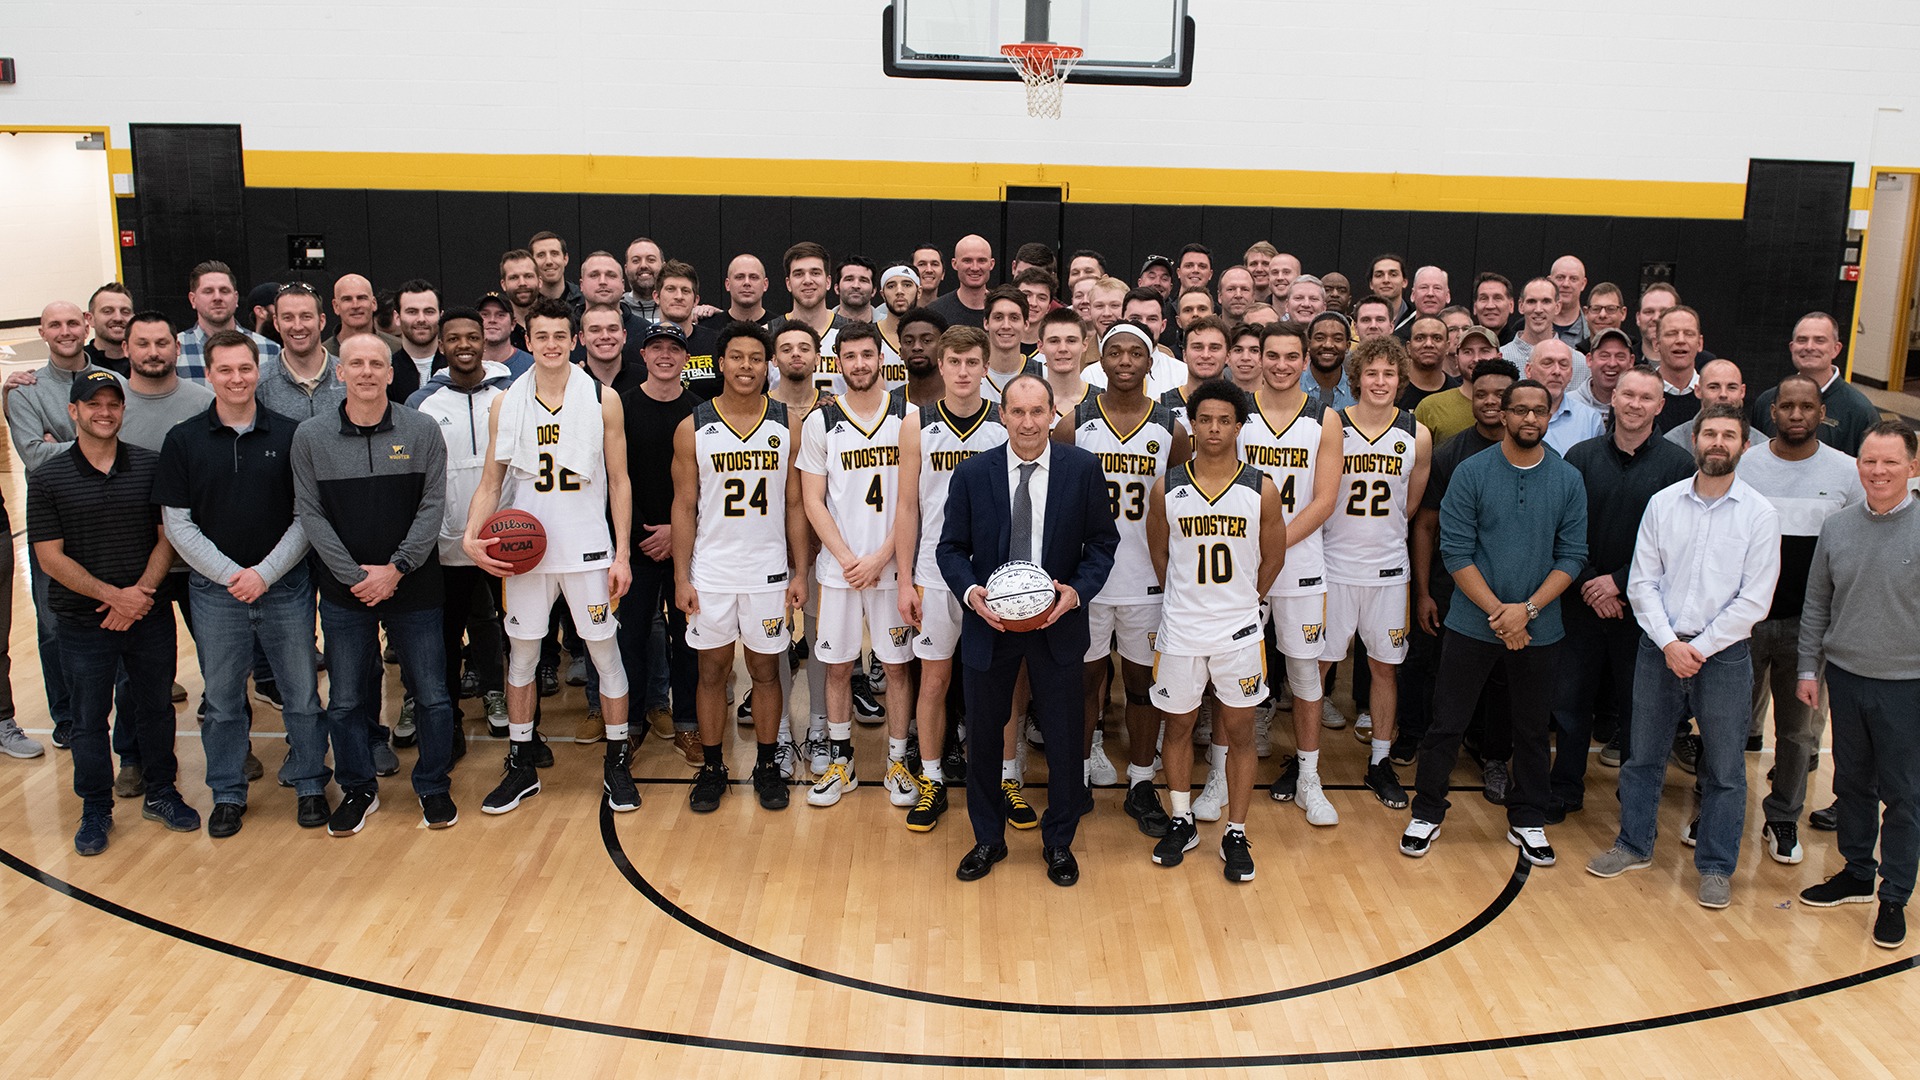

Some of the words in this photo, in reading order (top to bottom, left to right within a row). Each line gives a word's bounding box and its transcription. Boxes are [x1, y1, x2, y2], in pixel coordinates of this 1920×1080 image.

[680, 367, 716, 379] ETBALL
[682, 357, 714, 370] STER
[711, 450, 779, 473] WOOSTER
[841, 446, 900, 471] WOOSTER
[1245, 445, 1309, 468] WOOSTER
[534, 452, 581, 492] 32
[724, 477, 768, 517] 24
[865, 473, 884, 513] 4
[1346, 480, 1391, 517] 22
[490, 519, 536, 534] Wilson
[1178, 515, 1247, 538] WOOSTER
[500, 540, 534, 552] NCAA
[1197, 543, 1233, 585] 10
